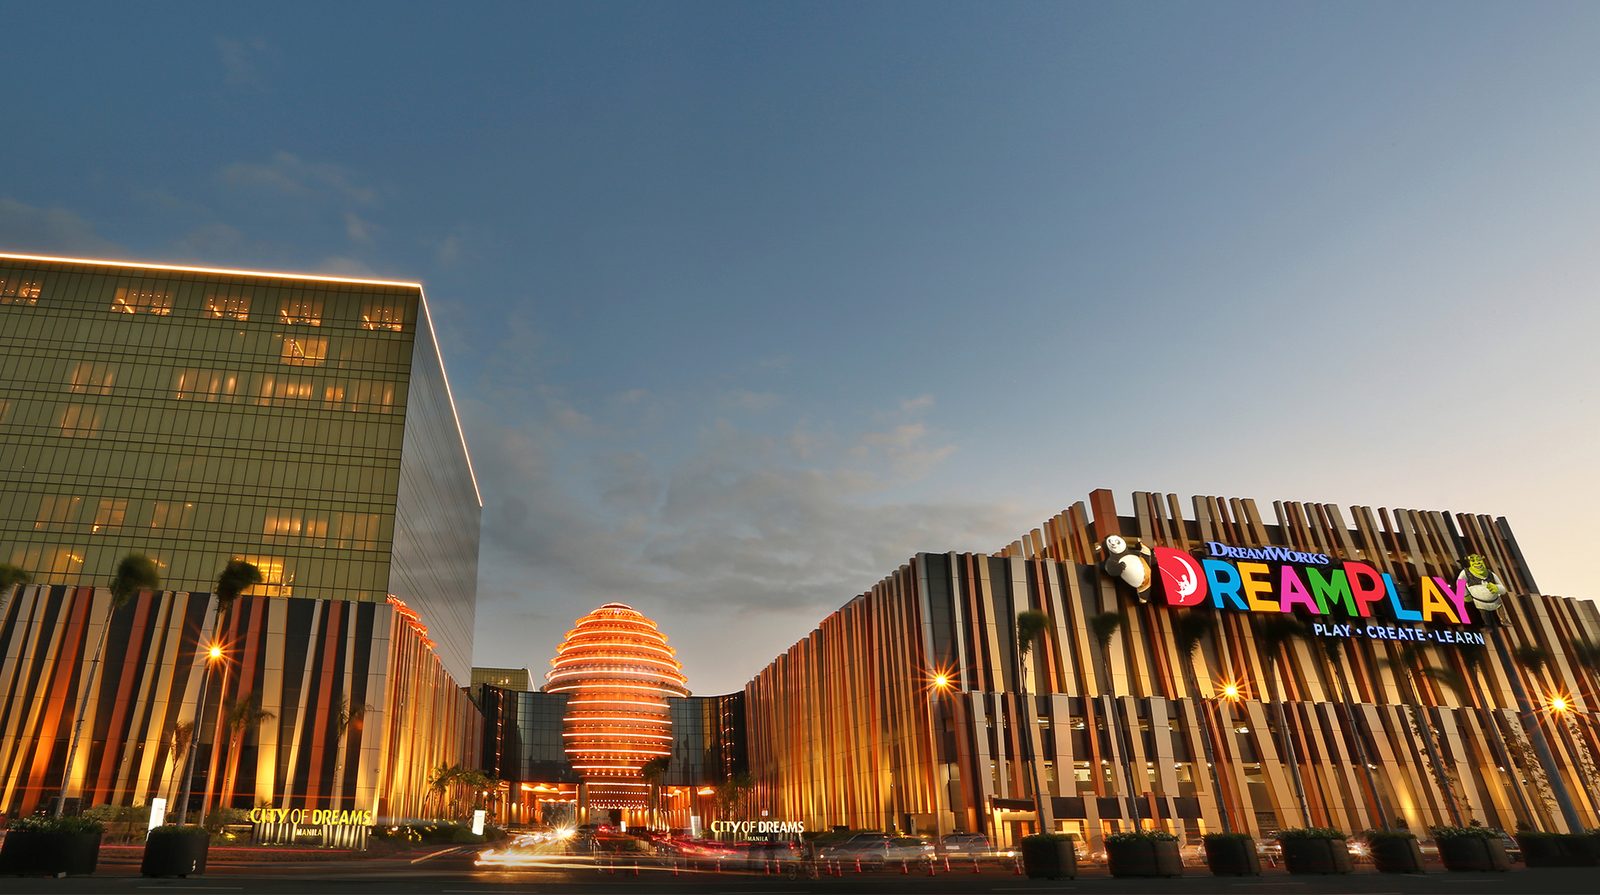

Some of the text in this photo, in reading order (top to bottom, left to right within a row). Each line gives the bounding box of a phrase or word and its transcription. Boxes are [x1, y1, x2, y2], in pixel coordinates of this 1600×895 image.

[1206, 540, 1330, 566] DREAMWORKS
[1153, 546, 1472, 625] DREAMPLAY
[1313, 623, 1486, 646] PLAY CREATE LEARN
[249, 808, 372, 826] CITY OF DREAMS
[710, 820, 805, 834] CITY OF DREAMS
[296, 828, 323, 836] MANILA
